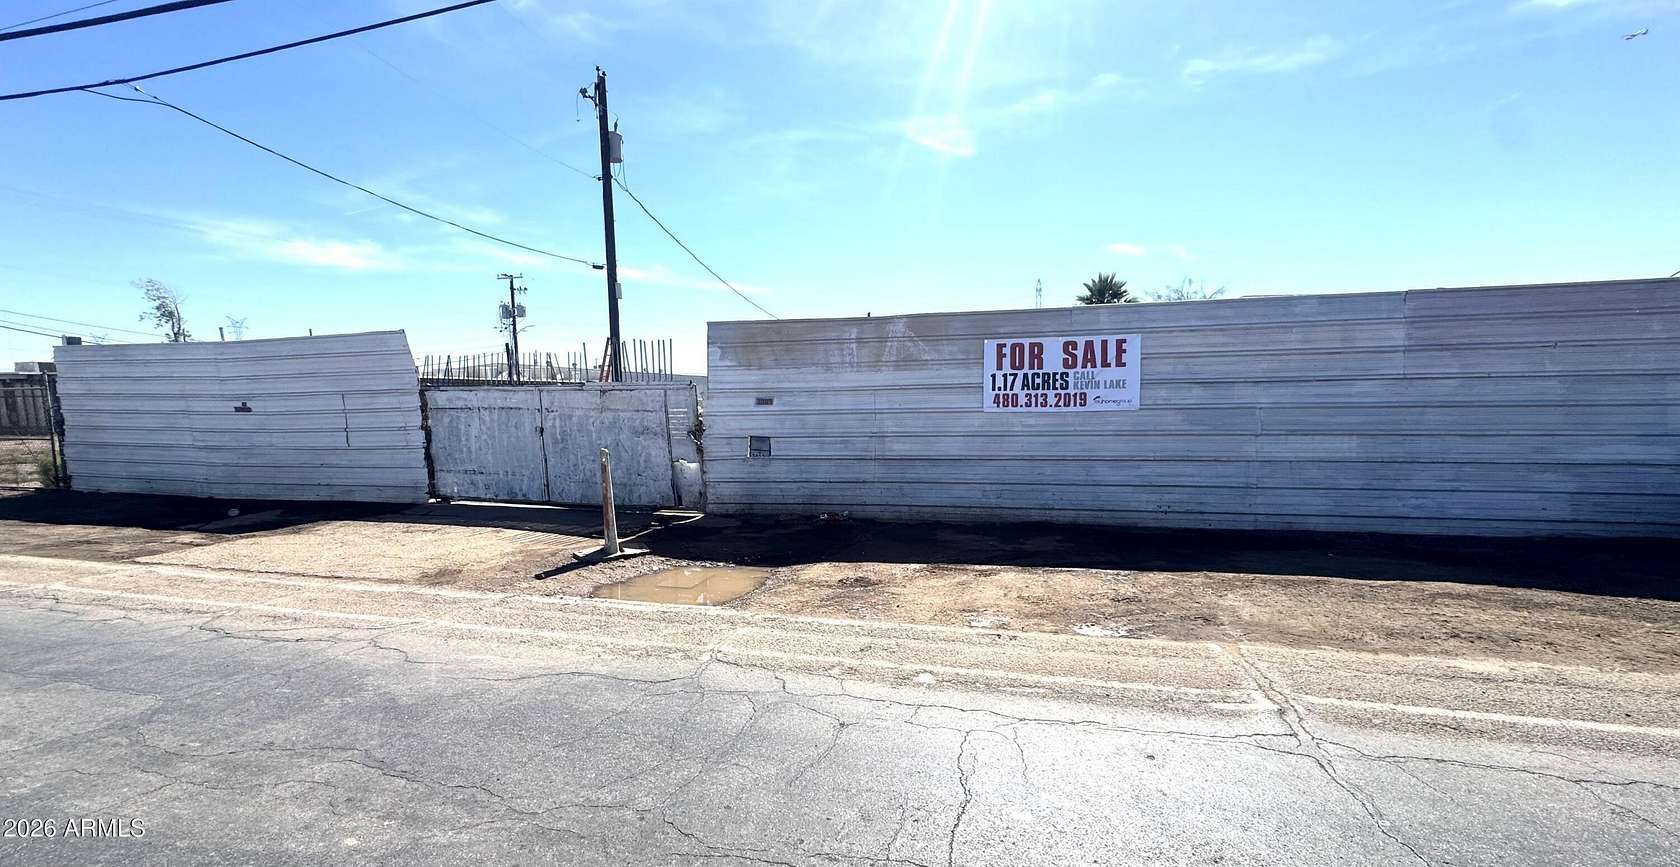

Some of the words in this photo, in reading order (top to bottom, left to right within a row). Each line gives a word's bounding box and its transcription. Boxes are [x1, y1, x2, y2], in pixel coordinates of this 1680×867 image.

[996, 342, 1044, 371] FOR
[1062, 338, 1127, 370] SALE
[990, 372, 1018, 391] 1.17
[1021, 371, 1069, 391] ACRES
[1073, 371, 1095, 380] CALL
[1073, 380, 1100, 390] KEVIN
[1104, 379, 1127, 389] LAKE
[993, 392, 1087, 408] 480.313.2019
